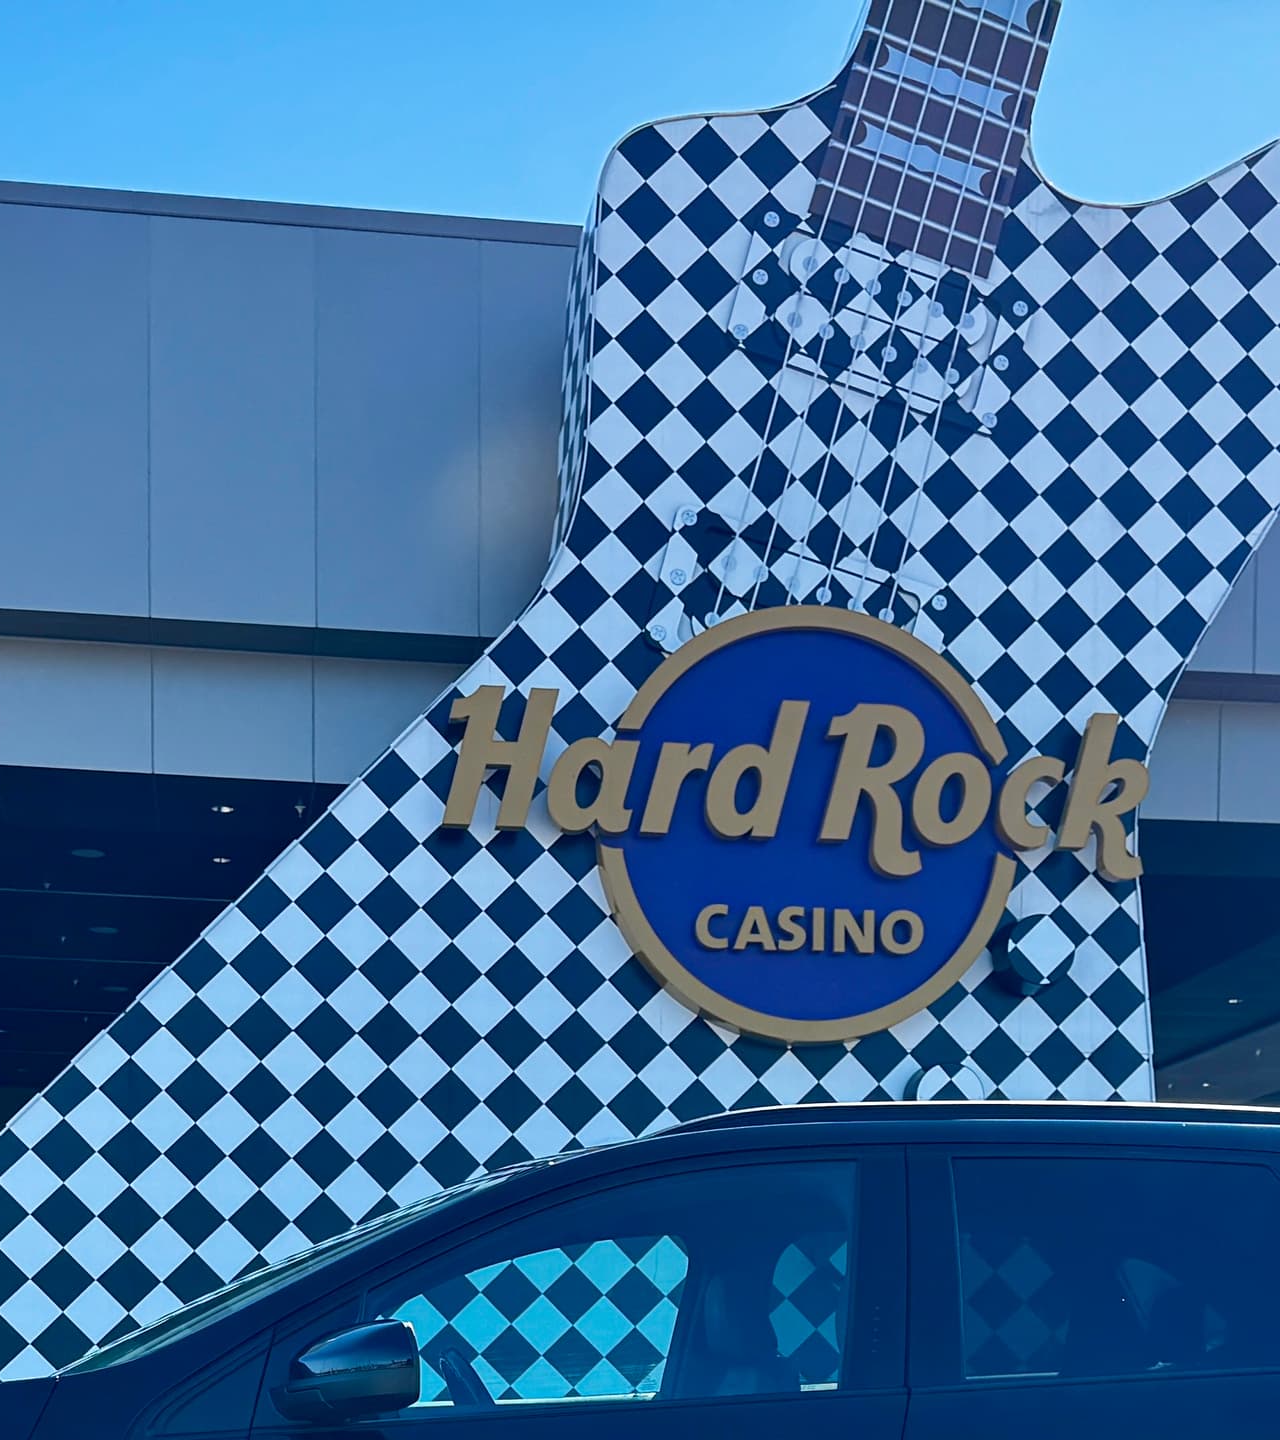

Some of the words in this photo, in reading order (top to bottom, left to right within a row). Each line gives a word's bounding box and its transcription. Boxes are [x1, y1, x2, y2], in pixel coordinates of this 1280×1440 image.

[441, 684, 811, 840] Hard
[816, 702, 1150, 882] Rock
[695, 903, 925, 955] CASINO
